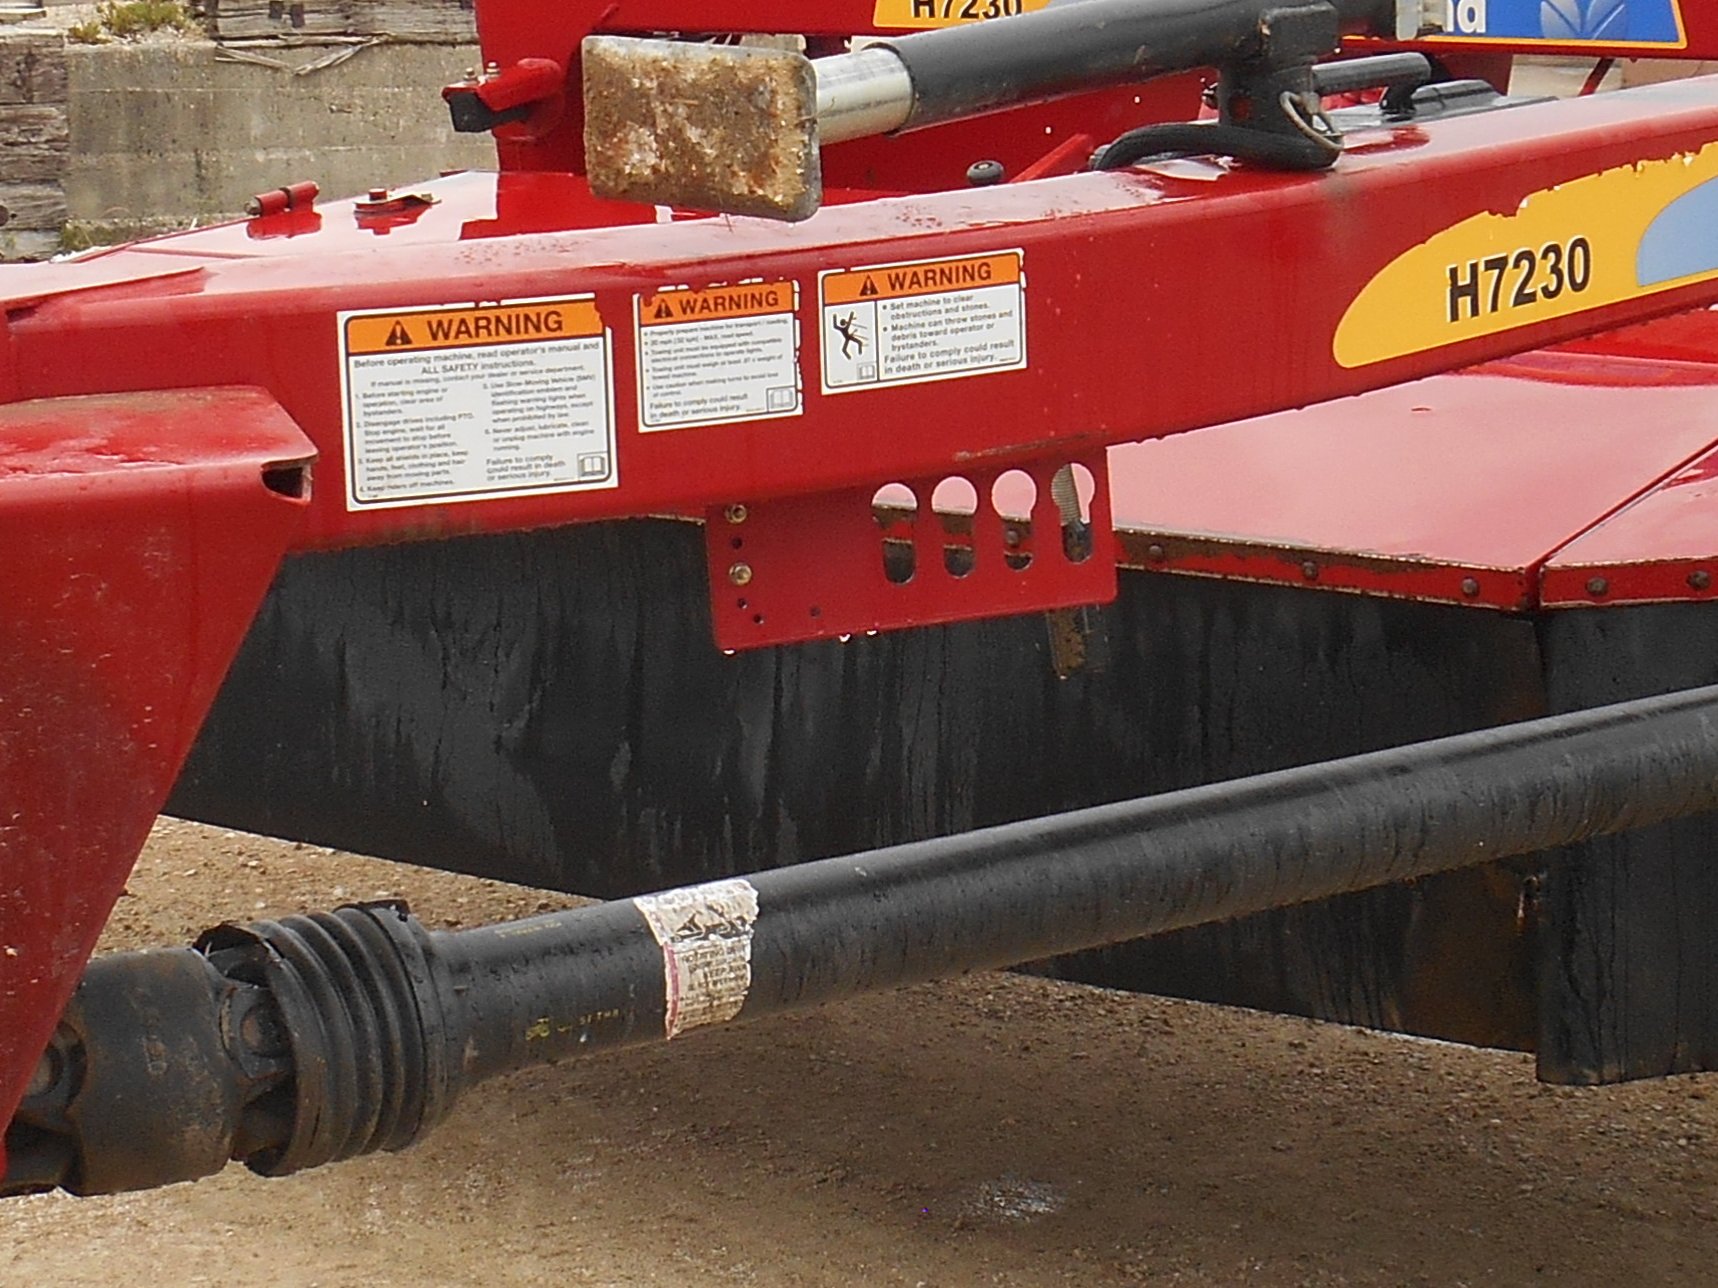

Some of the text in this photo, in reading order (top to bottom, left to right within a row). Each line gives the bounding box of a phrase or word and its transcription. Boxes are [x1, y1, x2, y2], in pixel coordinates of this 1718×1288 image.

[887, 261, 991, 291] WARNING
[1447, 234, 1592, 324] H7230
[679, 289, 778, 315] WARNING
[889, 293, 973, 310] Set machine to clear
[890, 301, 989, 320] obstructions and stones.
[427, 311, 563, 342] WARNING
[890, 310, 1012, 332] Machine can throw stones and
[891, 322, 994, 341] debris toward operator or
[884, 339, 1014, 363] Failure to comply could result
[890, 338, 938, 352] bystanders.
[353, 341, 599, 368] Before operating machine, read operator's manual and
[884, 365, 893, 374] in
[895, 362, 921, 372] death
[923, 360, 933, 369] or
[935, 356, 966, 367] serious
[968, 352, 996, 365] injury.
[421, 358, 535, 374] ALL SAFETY instructions.
[362, 391, 385, 399] Before
[387, 389, 414, 398] starting
[415, 387, 438, 396] engine
[649, 392, 748, 409] Failure to comply could result
[363, 408, 403, 417] bystanders.
[650, 411, 657, 419] in
[659, 409, 679, 417] death
[691, 404, 717, 414] serious
[719, 402, 740, 412] injury.
[485, 456, 512, 465] Failure
[524, 453, 552, 463] comply
[486, 465, 508, 473] could
[510, 463, 532, 471] result
[543, 460, 565, 468] death
[497, 472, 526, 480] serious
[528, 469, 550, 479] injury.
